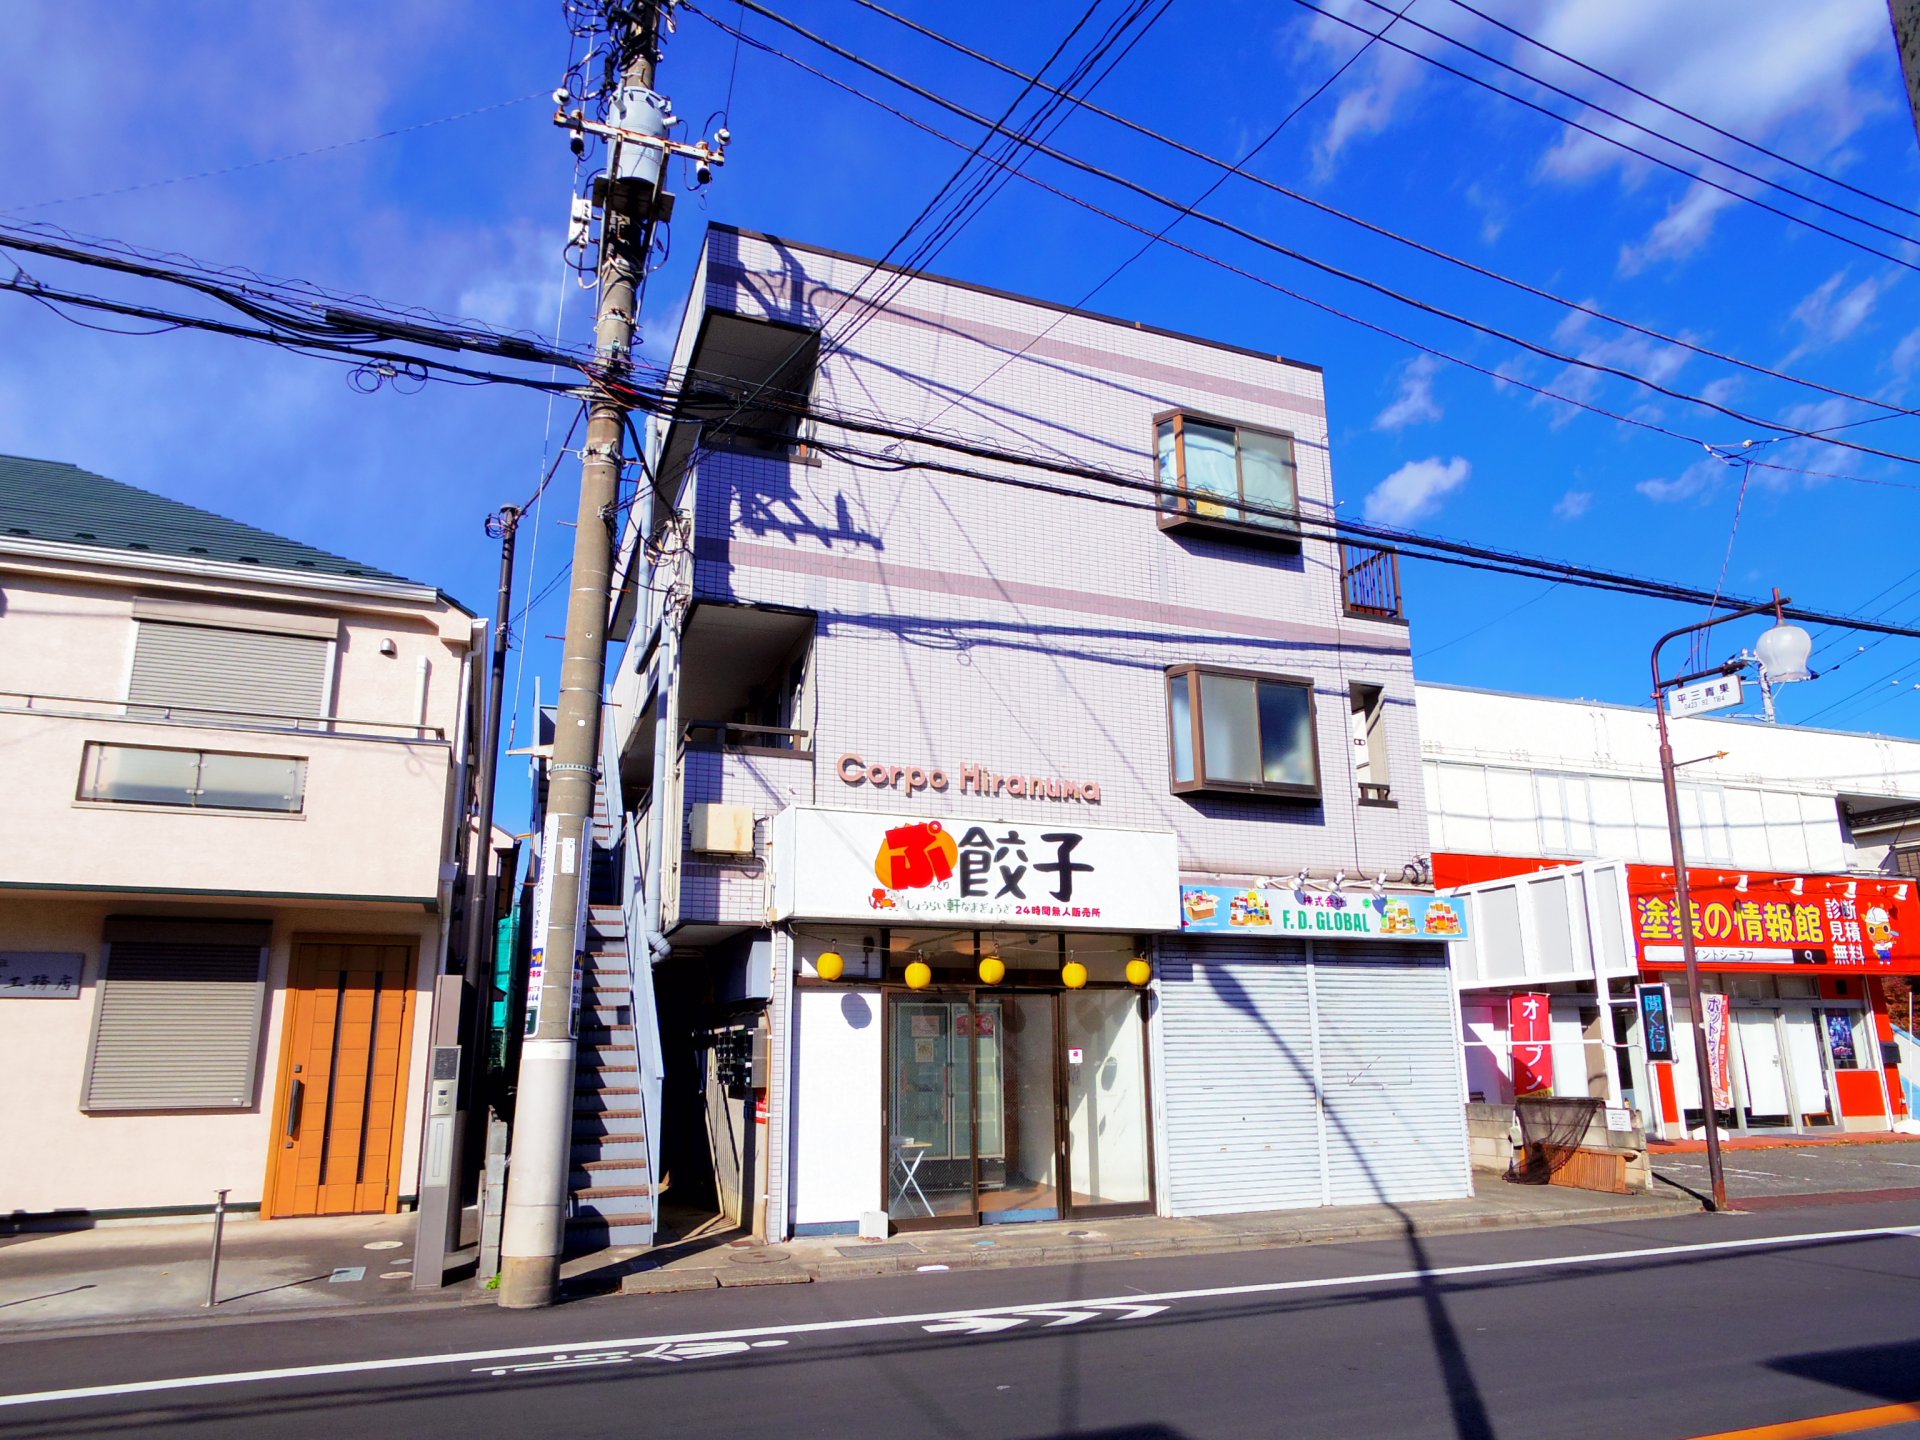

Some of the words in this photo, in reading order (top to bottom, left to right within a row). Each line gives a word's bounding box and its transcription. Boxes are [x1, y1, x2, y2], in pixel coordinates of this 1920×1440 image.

[836, 753, 948, 796] Corpo
[960, 762, 1102, 803] Hiranuma
[1303, 896, 1346, 908] 株式会社
[1824, 898, 1857, 920] 診断
[1283, 909, 1294, 930] F.
[1298, 910, 1313, 930] D.
[1317, 911, 1370, 933] GLOBAL
[1637, 896, 1824, 943] 塗装の情報館
[1830, 920, 1861, 943] 見積
[1695, 949, 1754, 961] イントジーラフ
[1832, 943, 1865, 966] 無料
[0, 974, 73, 991] 工務店
[1644, 994, 1666, 1053] 聞くだけ
[1522, 998, 1543, 1091] オープン
